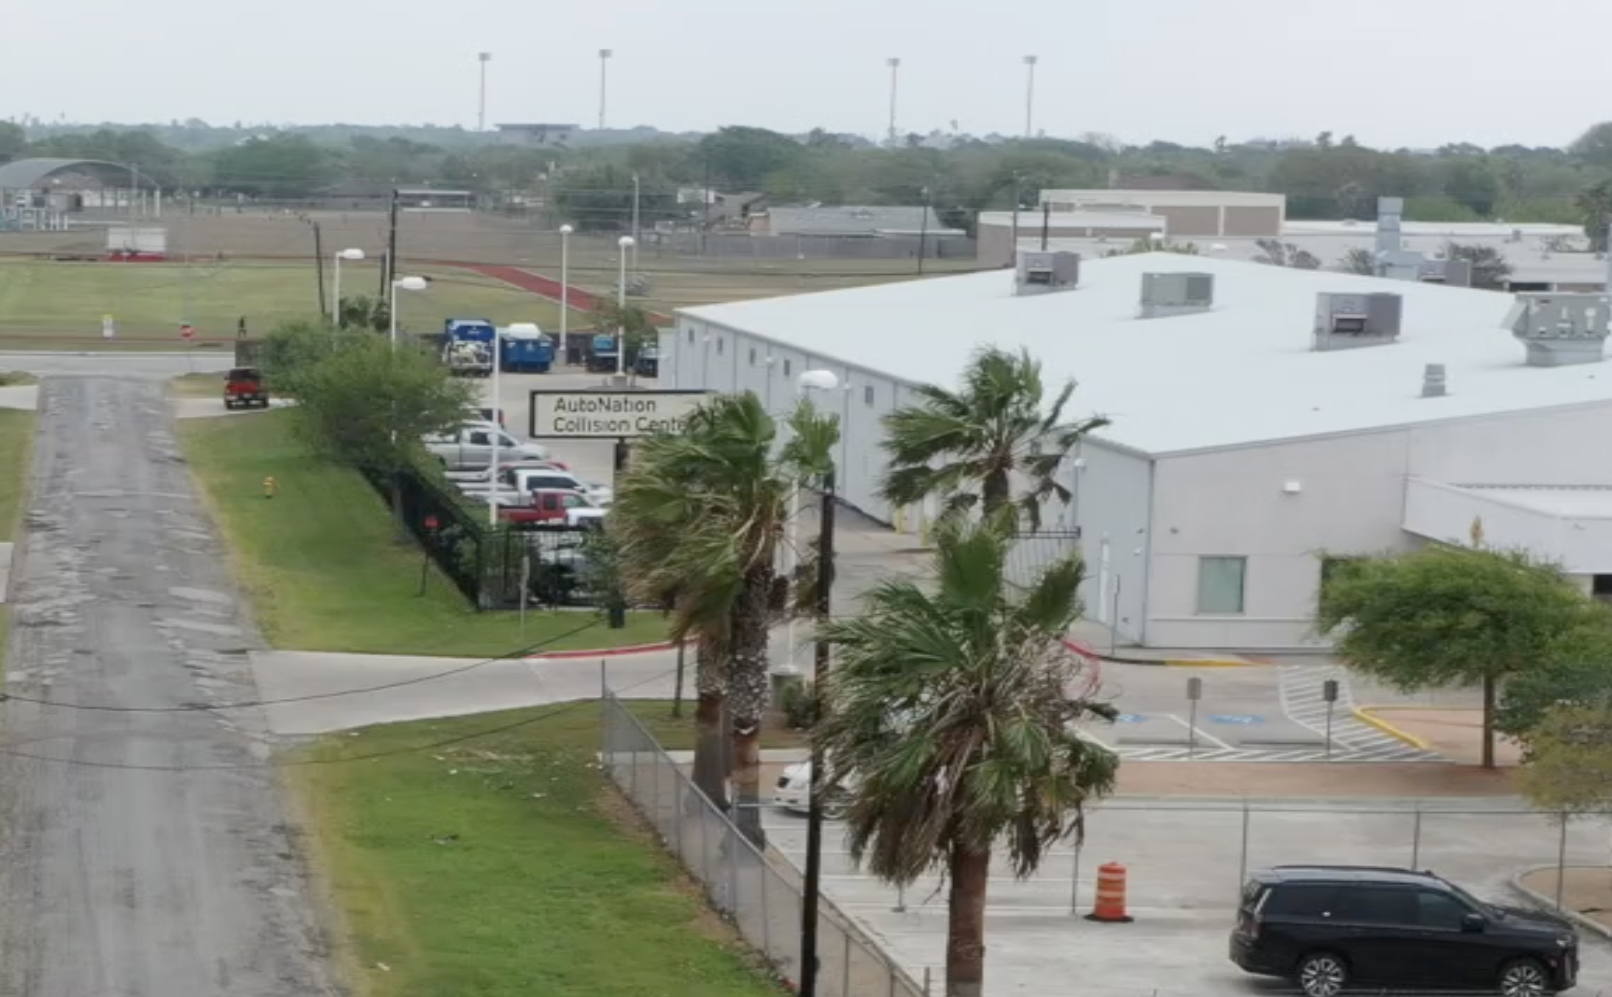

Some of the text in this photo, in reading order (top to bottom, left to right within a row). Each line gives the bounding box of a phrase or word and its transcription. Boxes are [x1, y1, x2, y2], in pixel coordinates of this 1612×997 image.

[554, 397, 656, 413] AutoNation
[554, 416, 693, 432] Collision Cente
